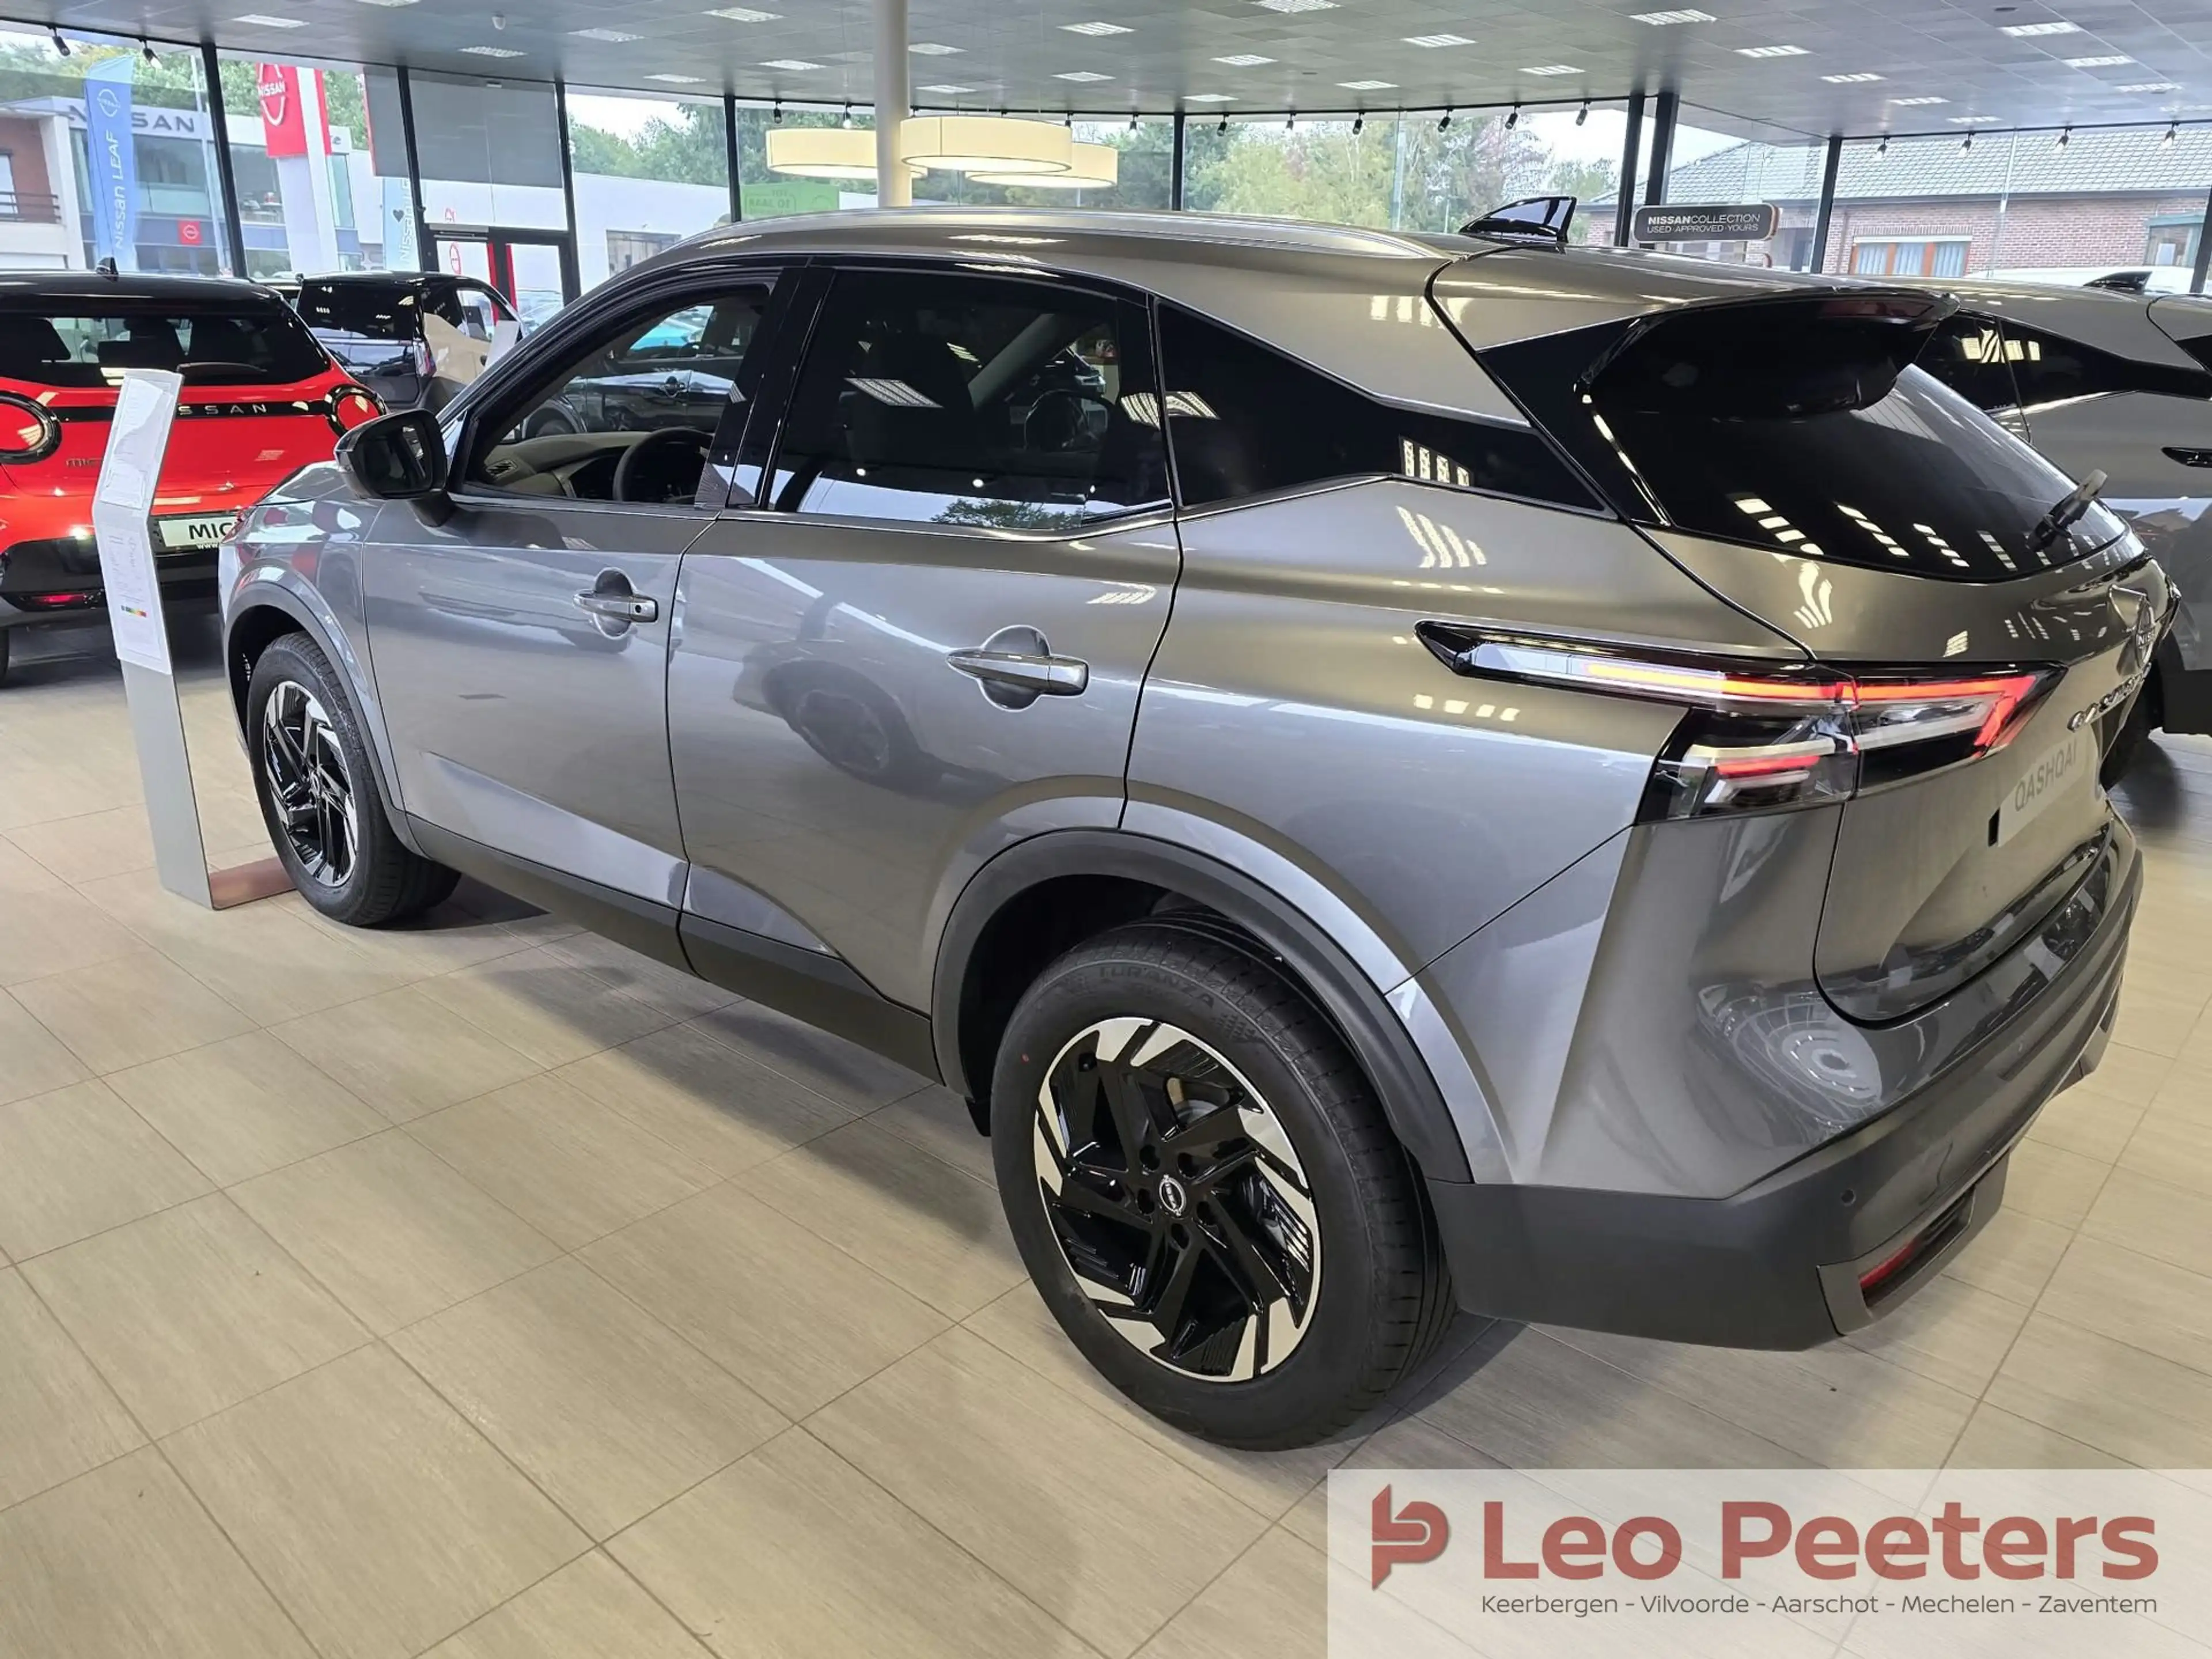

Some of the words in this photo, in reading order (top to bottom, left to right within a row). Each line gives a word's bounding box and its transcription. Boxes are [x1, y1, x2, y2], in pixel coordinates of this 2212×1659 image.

[258, 80, 286, 97] NISSAN
[67, 105, 195, 133] NSAN
[106, 129, 123, 180] LEAF
[189, 522, 233, 540] MIC
[2015, 738, 2077, 812] QASHQAI
